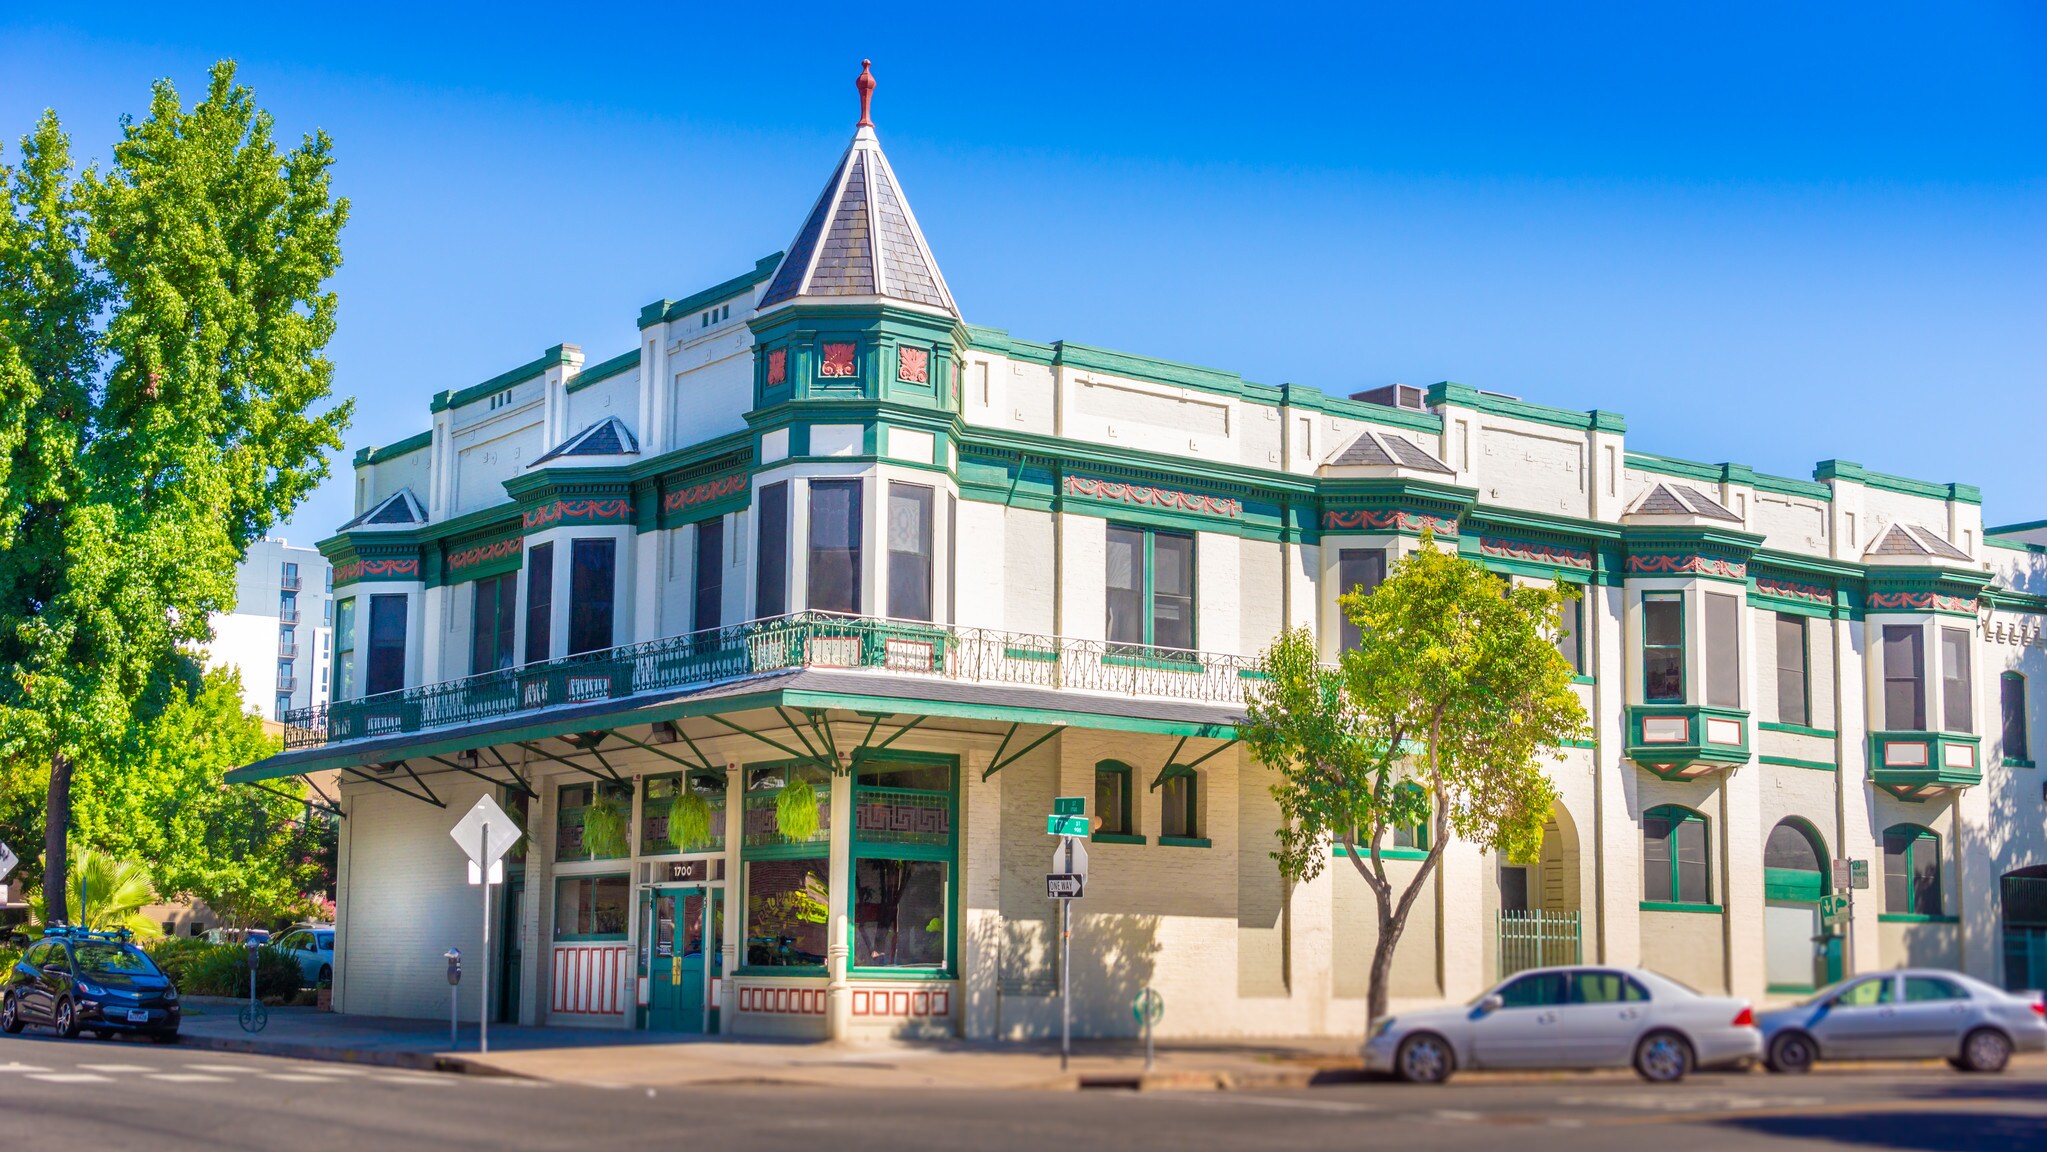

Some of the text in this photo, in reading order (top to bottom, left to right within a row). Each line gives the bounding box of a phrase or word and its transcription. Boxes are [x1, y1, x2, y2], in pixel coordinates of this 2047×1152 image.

[674, 866, 692, 877] 1700
[1050, 881, 1073, 891] ONE WAY
